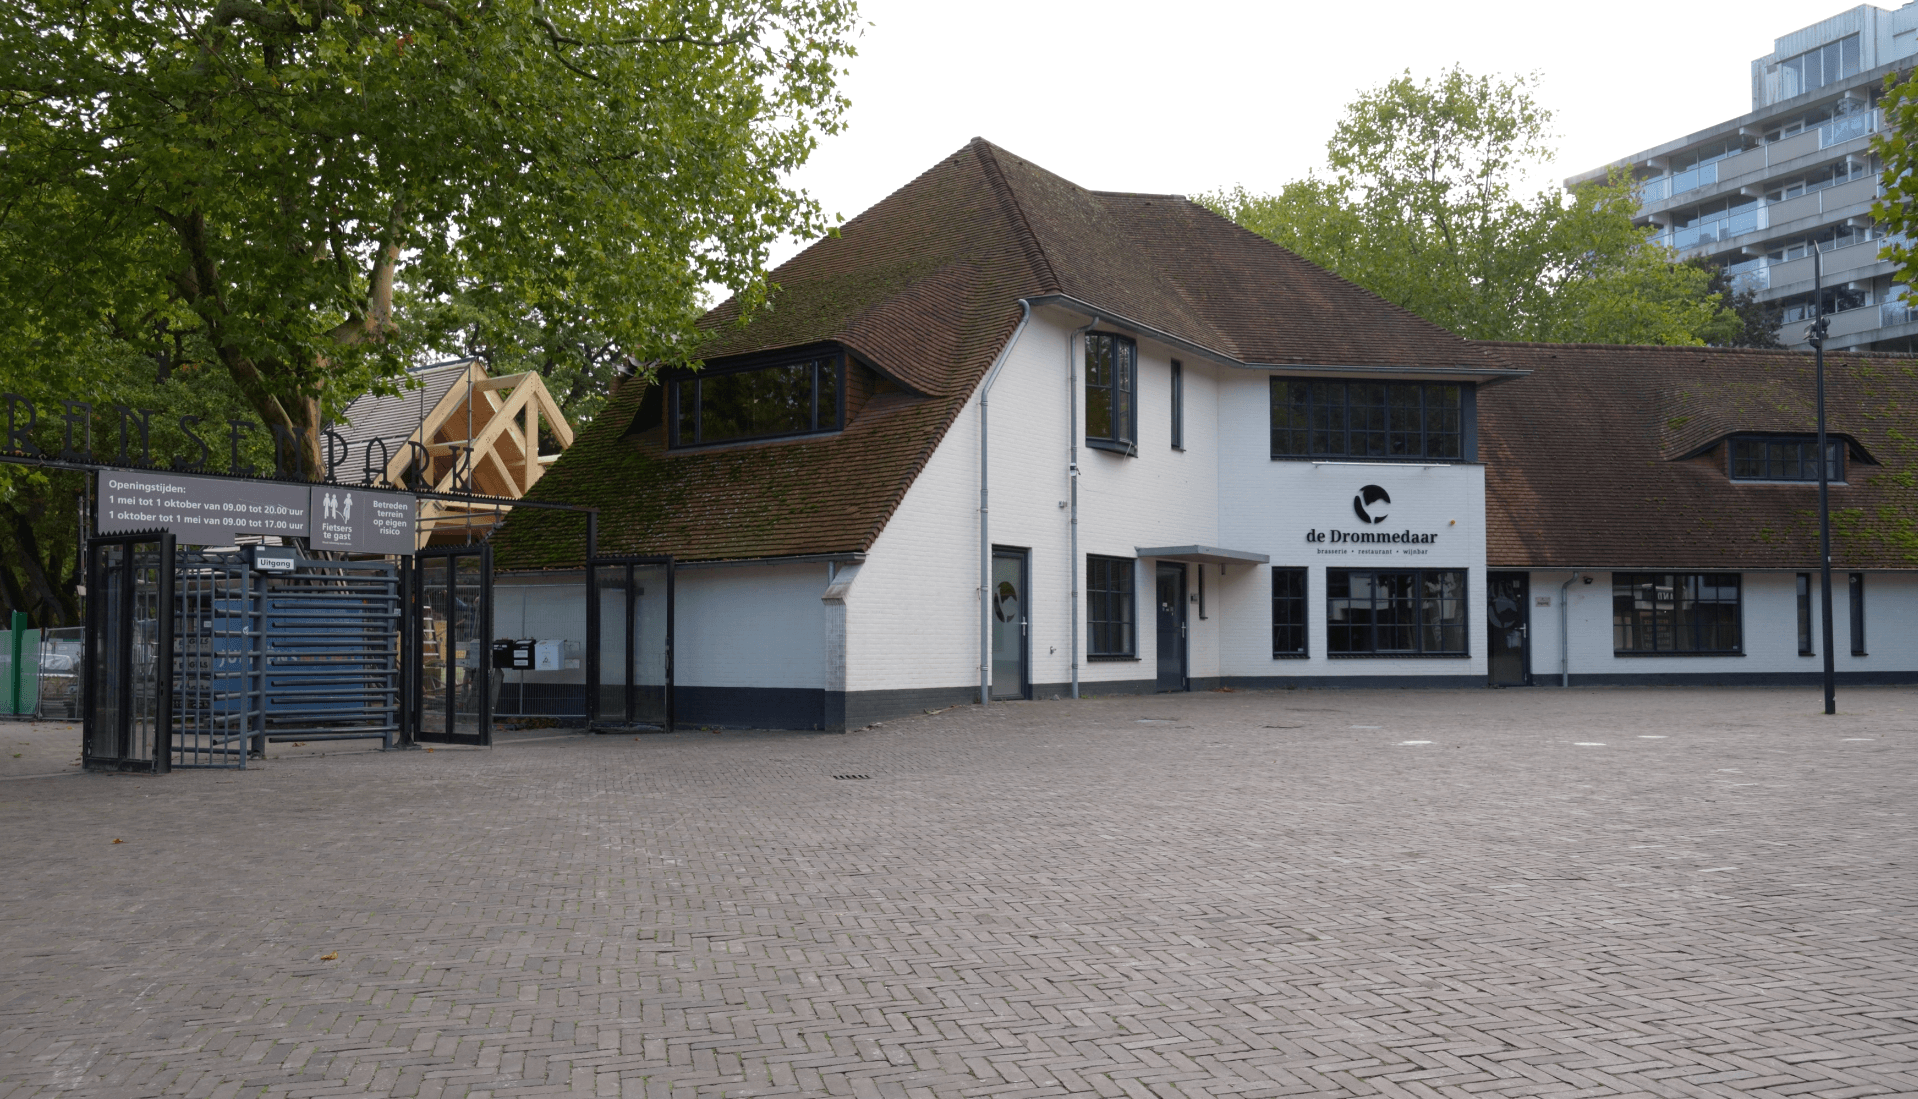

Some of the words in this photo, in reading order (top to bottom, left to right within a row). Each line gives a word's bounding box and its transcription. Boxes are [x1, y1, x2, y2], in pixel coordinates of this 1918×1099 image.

[108, 479, 186, 494] Openingstijden:
[109, 495, 114, 504] 1
[117, 496, 136, 506] mei
[138, 497, 153, 507] tot
[156, 498, 161, 507] 1
[164, 499, 201, 510] oktober
[203, 503, 221, 511] van
[222, 503, 247, 513] 09.00
[248, 505, 263, 514] tot
[264, 505, 287, 515] 20.00
[289, 508, 304, 516] uur
[372, 500, 408, 511] Betreden
[377, 509, 404, 519] terrein
[108, 510, 114, 519] 1
[117, 511, 156, 522] oktober
[158, 513, 174, 523] tot
[176, 514, 181, 523] 1
[183, 514, 201, 524] mei
[203, 517, 221, 526] van
[222, 517, 247, 527] 09.00
[248, 519, 262, 528] tot
[264, 519, 287, 529] 17.00
[288, 522, 304, 530] uur
[373, 519, 384, 527] op
[385, 519, 407, 528] eigen
[322, 522, 353, 533] Fietsers
[379, 527, 400, 536] risico
[323, 531, 332, 539] te
[333, 533, 351, 541] gast
[1306, 528, 1326, 543] de
[1330, 529, 1438, 544] Drommedaar
[1402, 548, 1428, 556] wijnbar
[260, 559, 291, 568] Uitgang
